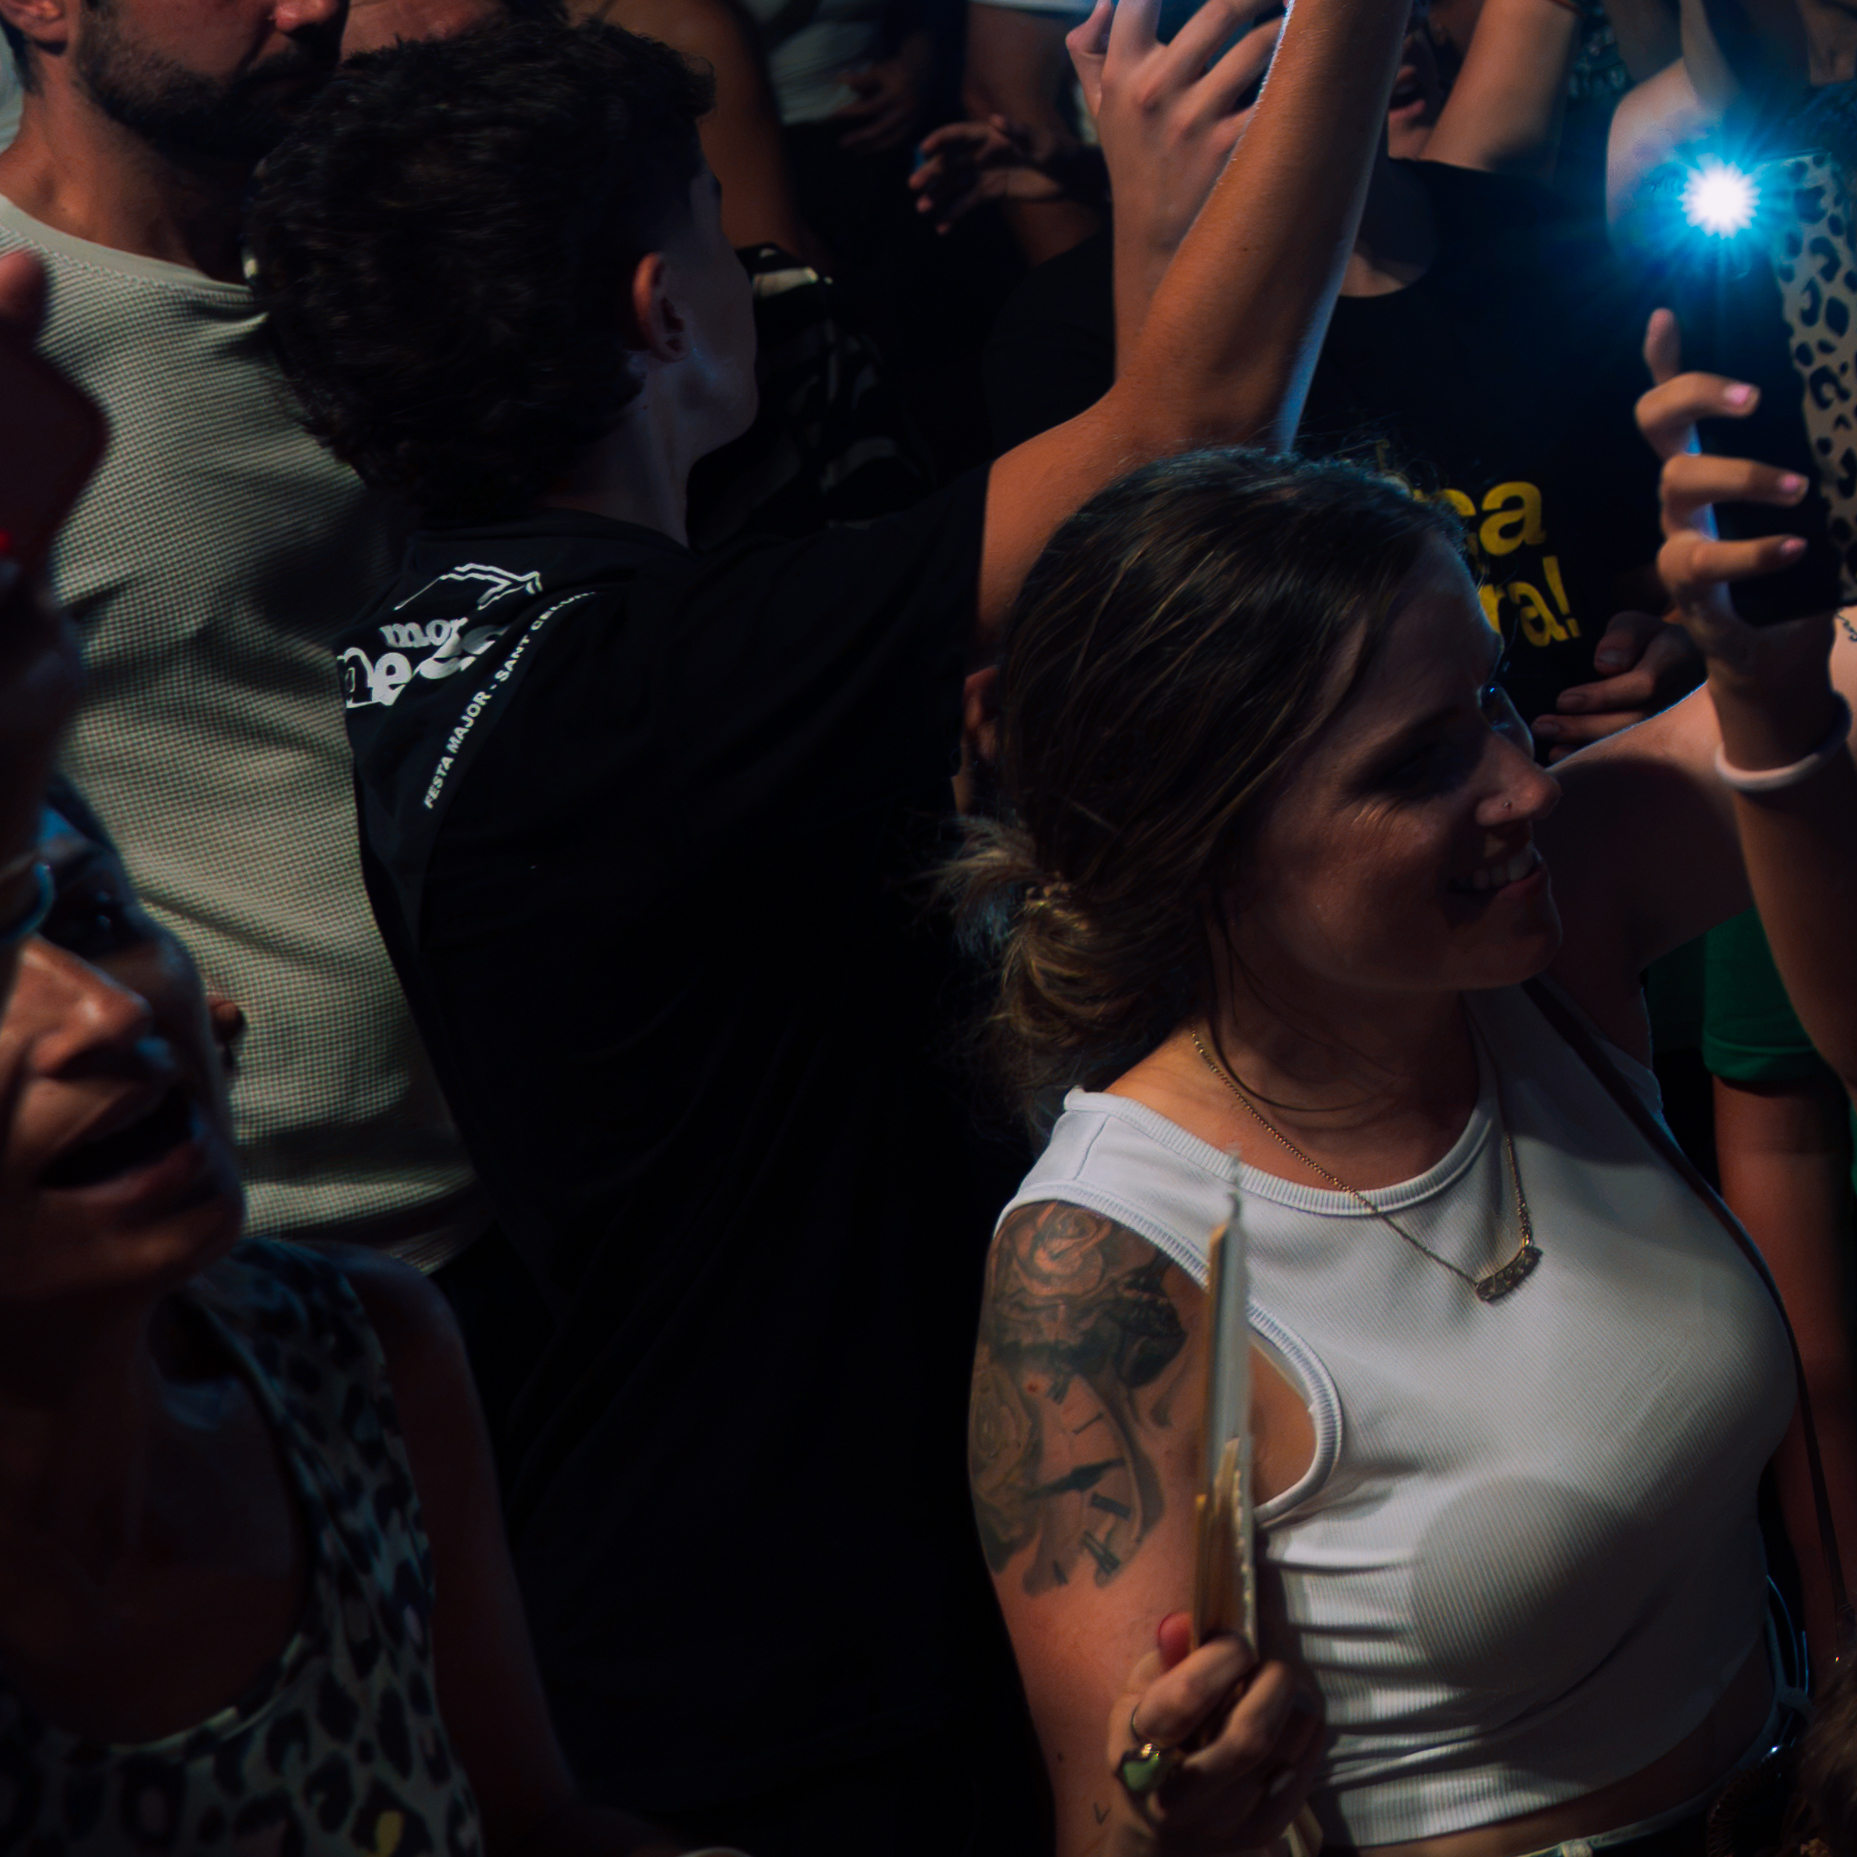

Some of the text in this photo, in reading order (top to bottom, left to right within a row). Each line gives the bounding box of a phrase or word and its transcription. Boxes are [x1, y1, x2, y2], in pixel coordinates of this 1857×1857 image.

[423, 753, 456, 810] FESTA
[445, 690, 494, 755] MAJOR
[493, 634, 531, 684] SANT
